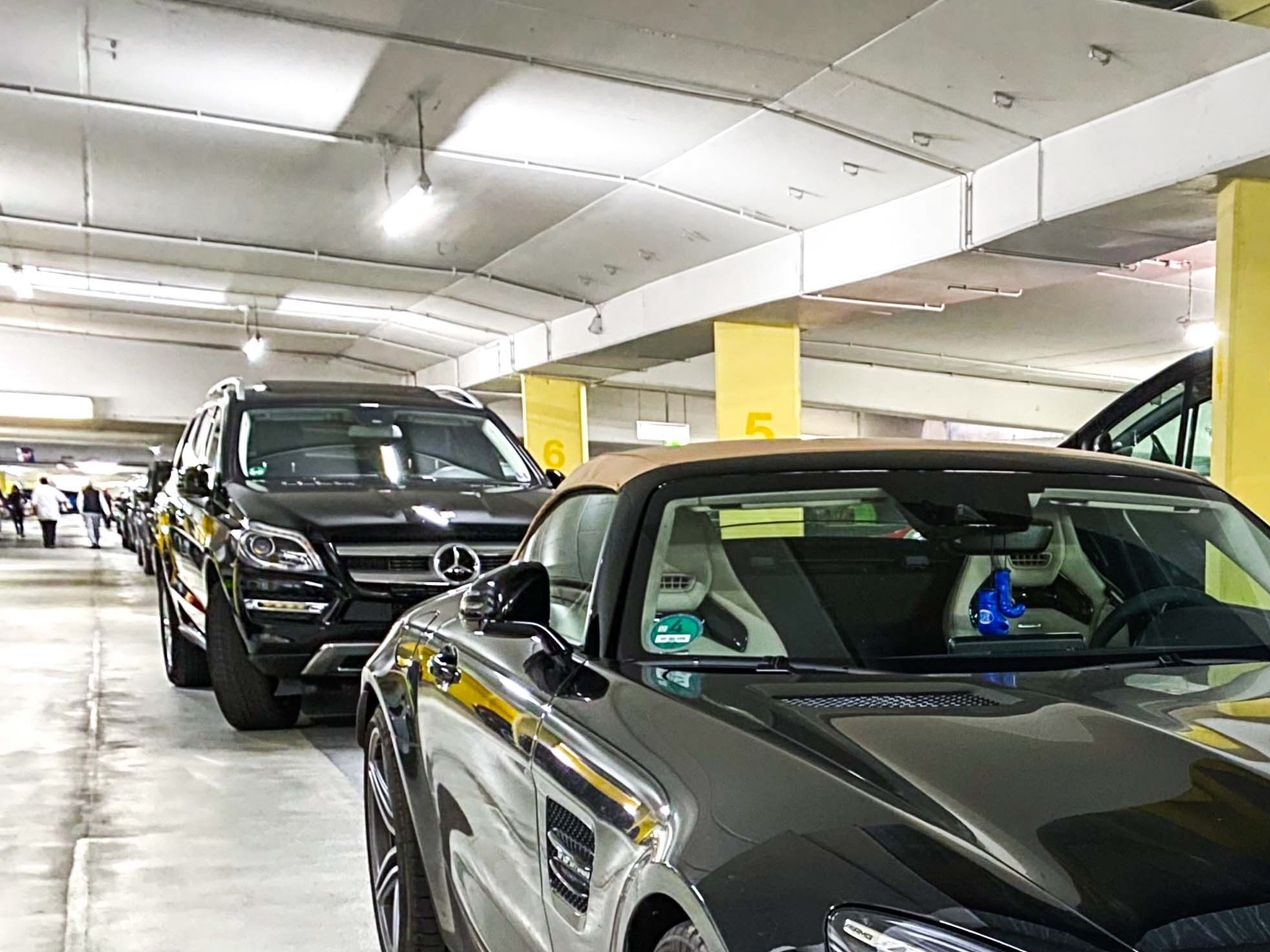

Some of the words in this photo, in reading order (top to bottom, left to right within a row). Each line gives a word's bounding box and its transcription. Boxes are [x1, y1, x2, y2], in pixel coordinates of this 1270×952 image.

[745, 411, 775, 440] 5
[542, 439, 566, 470] 6
[667, 618, 683, 633] 4
